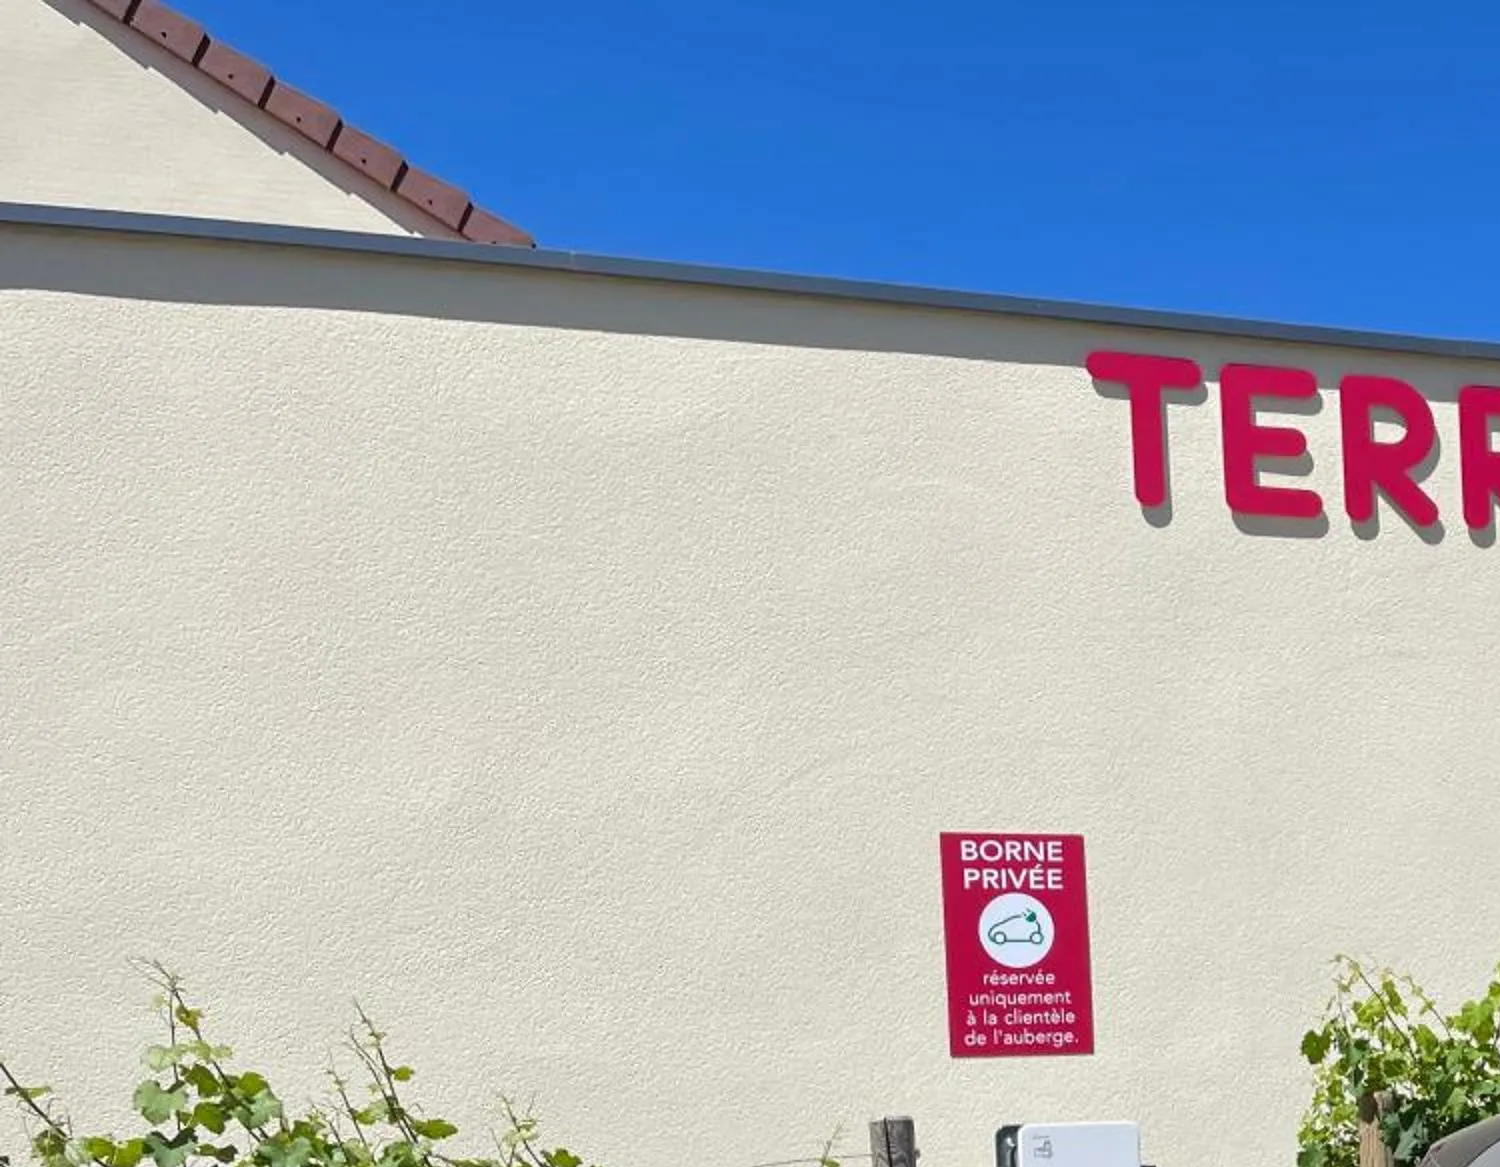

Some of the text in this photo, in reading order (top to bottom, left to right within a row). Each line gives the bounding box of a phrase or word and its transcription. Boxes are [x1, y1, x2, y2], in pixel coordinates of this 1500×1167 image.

[960, 840, 1064, 861] BORNE
[963, 864, 1064, 889] PRIVÉE
[983, 969, 1056, 985] réservée
[969, 991, 1071, 1008] uniquement
[966, 1008, 1076, 1025] à la clientèle
[964, 1028, 1079, 1047] de l'auberge.
